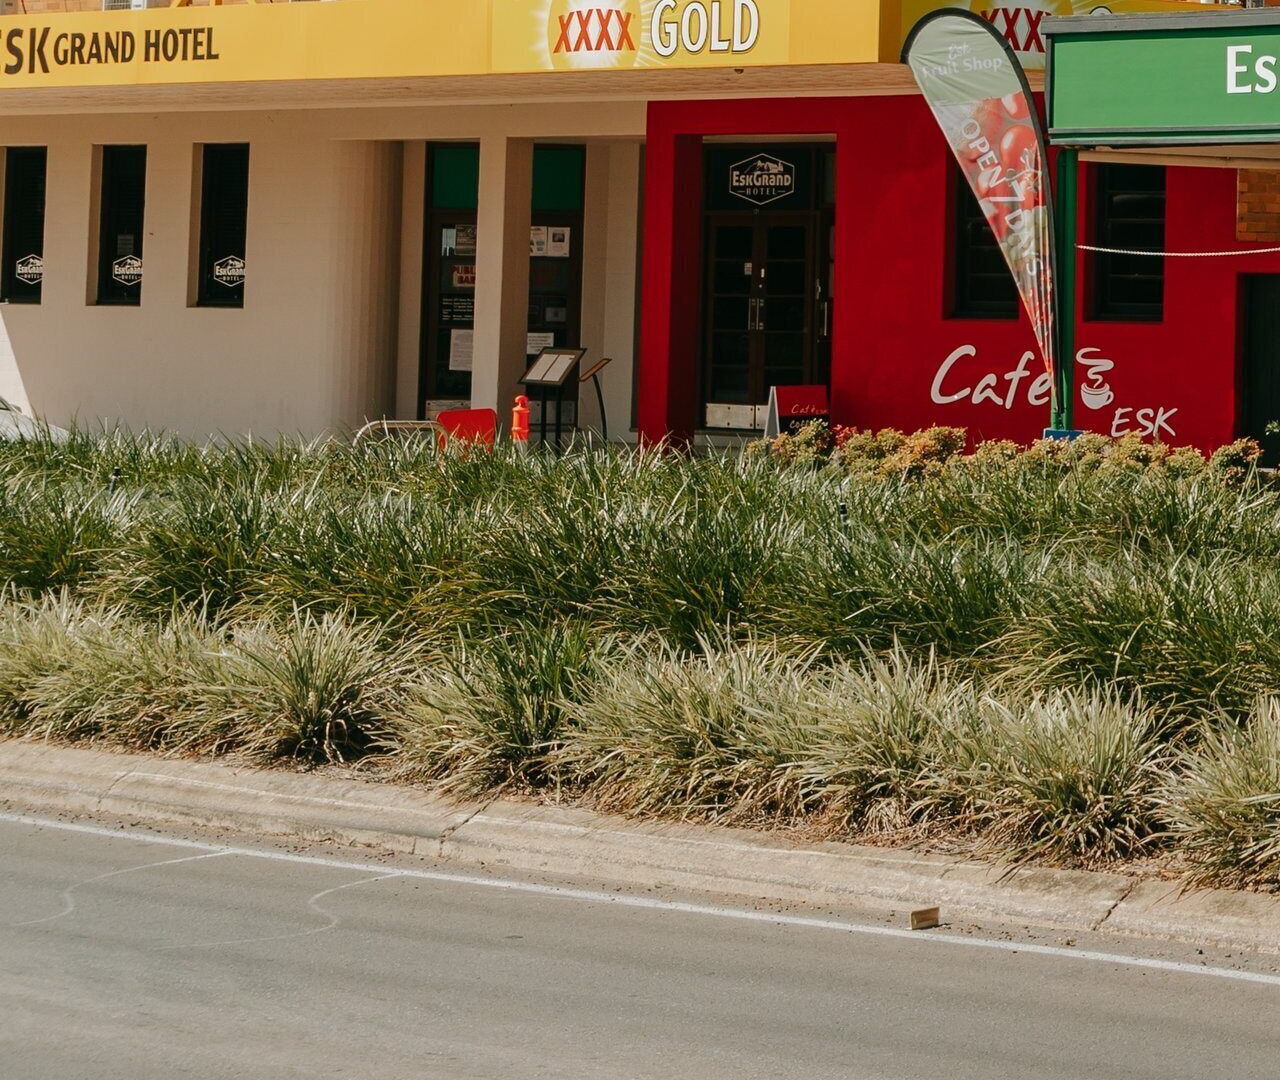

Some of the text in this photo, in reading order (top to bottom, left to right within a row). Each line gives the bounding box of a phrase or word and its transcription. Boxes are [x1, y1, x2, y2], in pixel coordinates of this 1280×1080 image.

[0, 27, 219, 74] SK GRAND HOTEL
[553, 8, 636, 54] XXXX
[963, 55, 1002, 72] Shop
[961, 119, 1007, 190] OPEN
[1111, 407, 1178, 437] ESK
